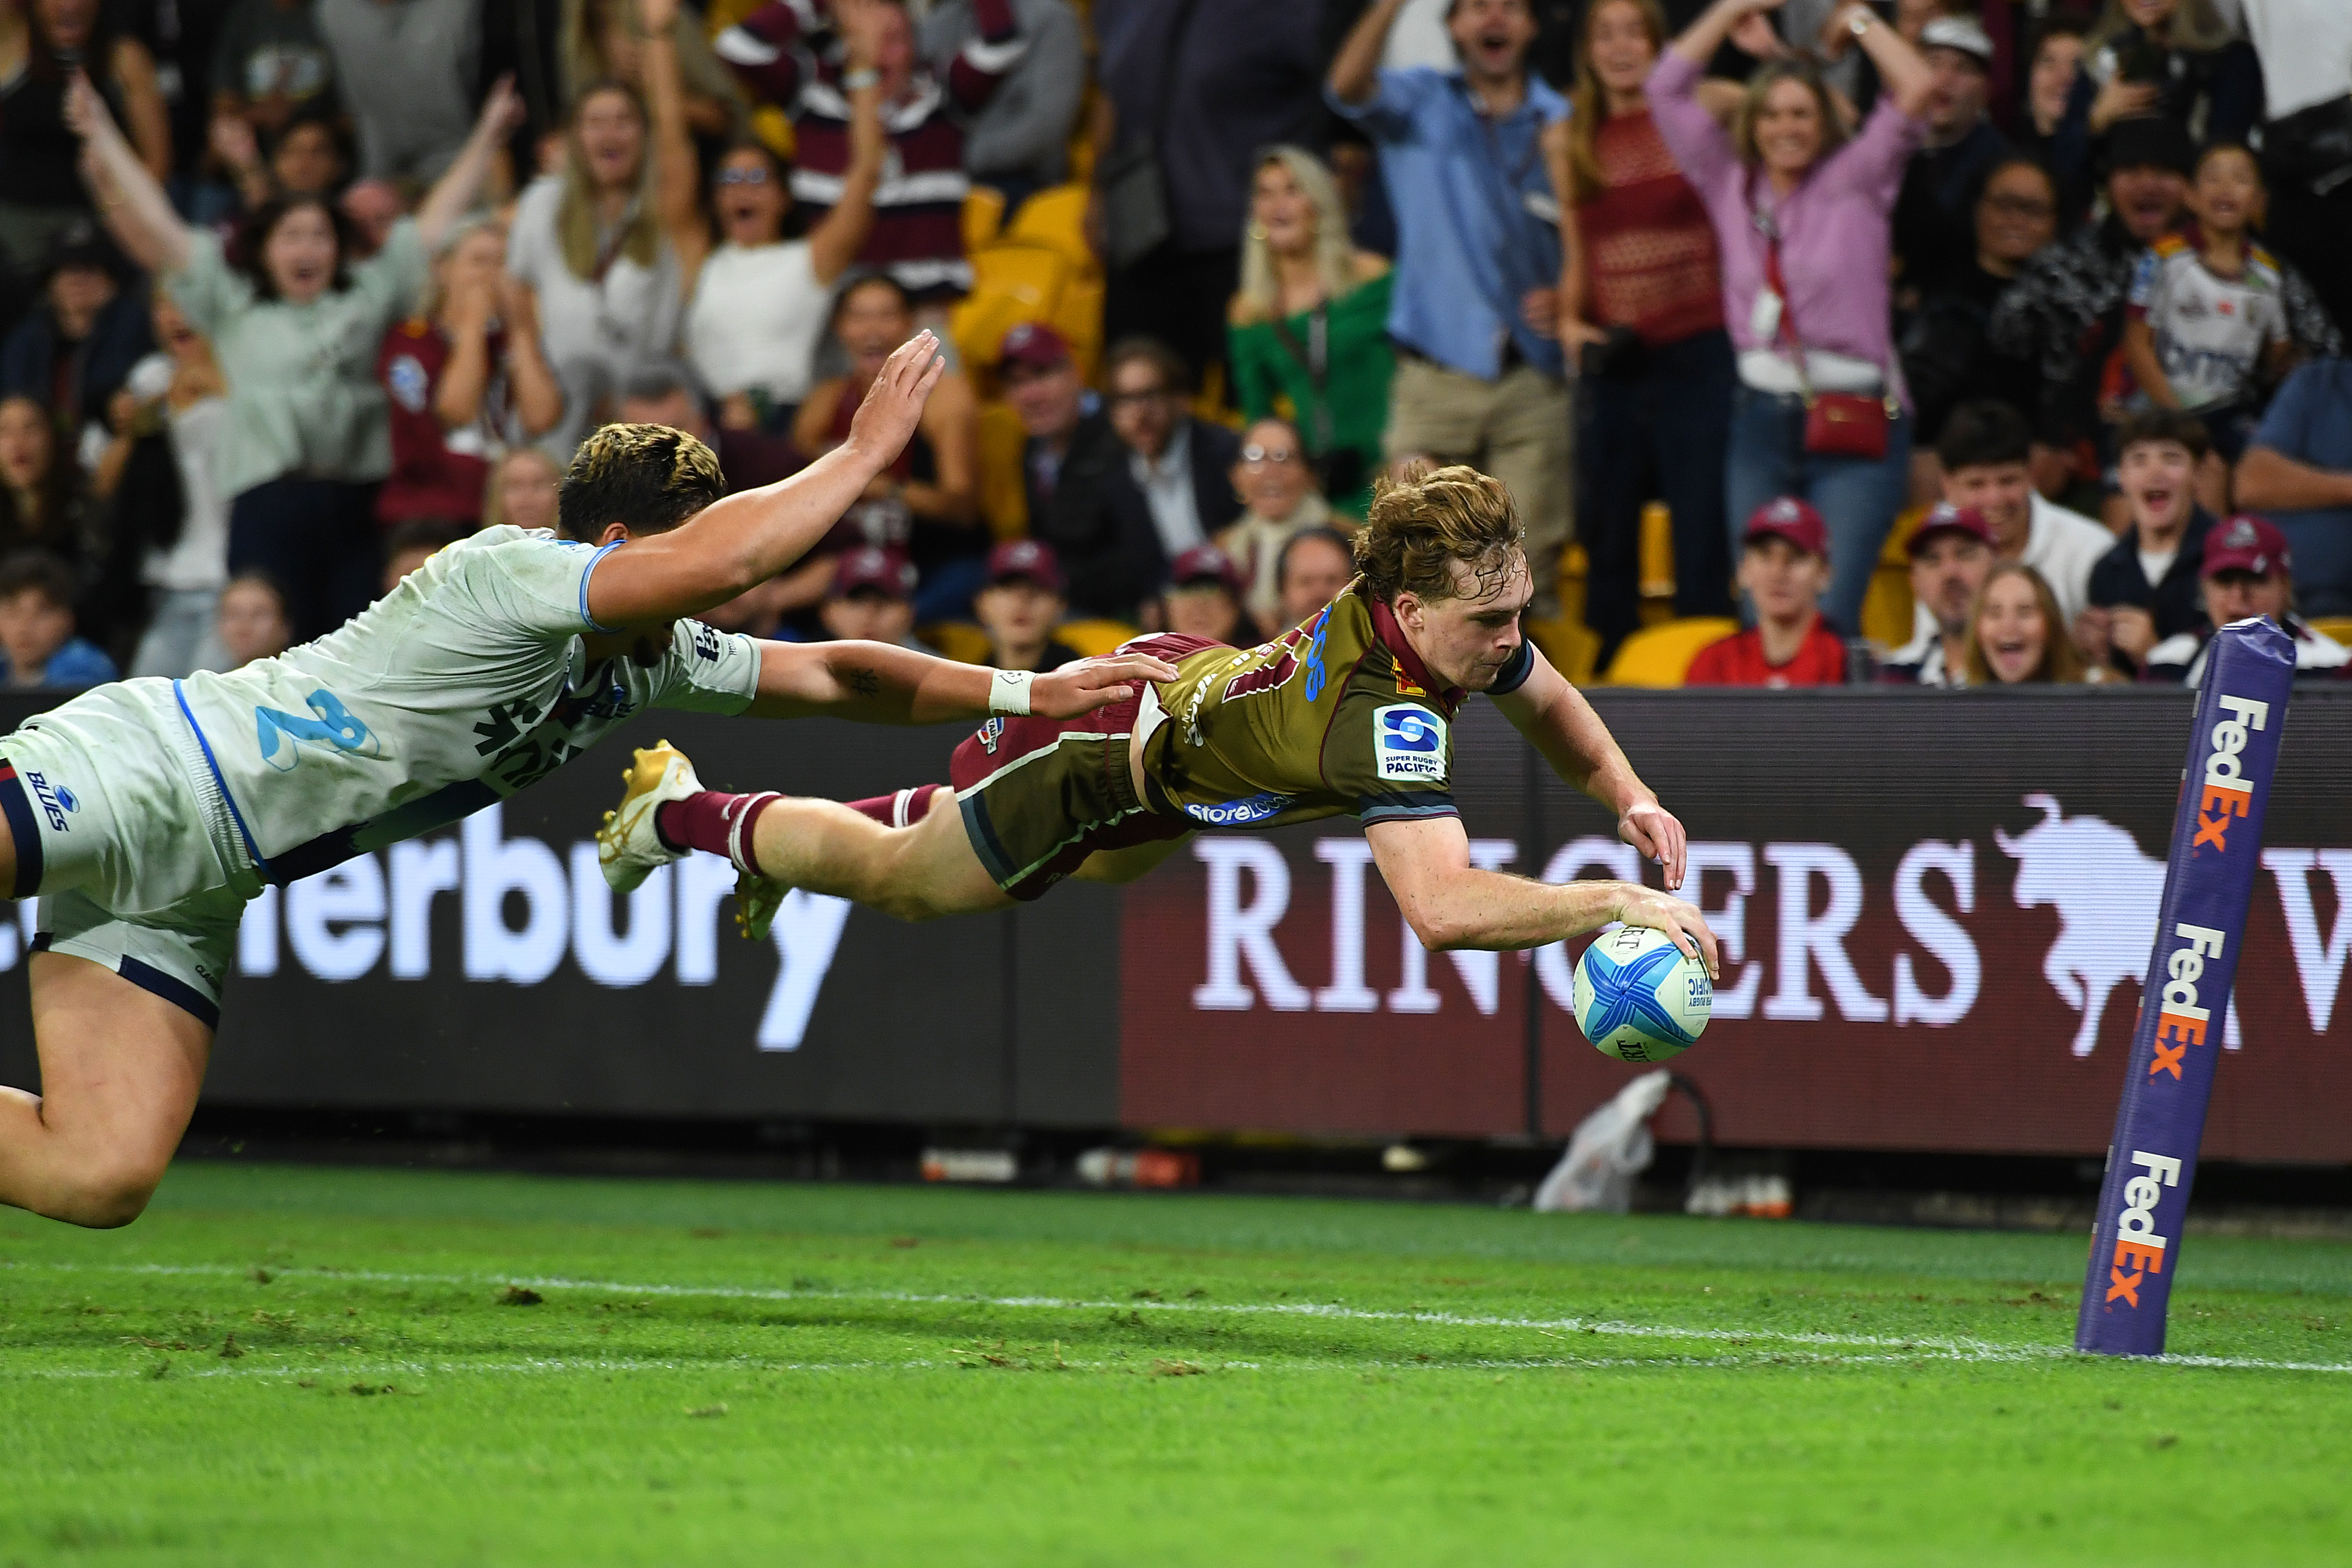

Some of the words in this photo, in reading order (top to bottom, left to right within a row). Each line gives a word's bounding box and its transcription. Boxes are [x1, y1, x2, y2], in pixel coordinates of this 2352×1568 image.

[255, 689, 380, 772] 2
[1412, 756, 1438, 766] RUGBY
[25, 771, 70, 832] BLUES
[1386, 763, 1438, 775] PACIFIC
[2193, 695, 2269, 852] FedEx
[1688, 978, 1712, 996] CIFIC
[2149, 922, 2226, 1082] FedEx
[2105, 1150, 2182, 1308] FedEx
